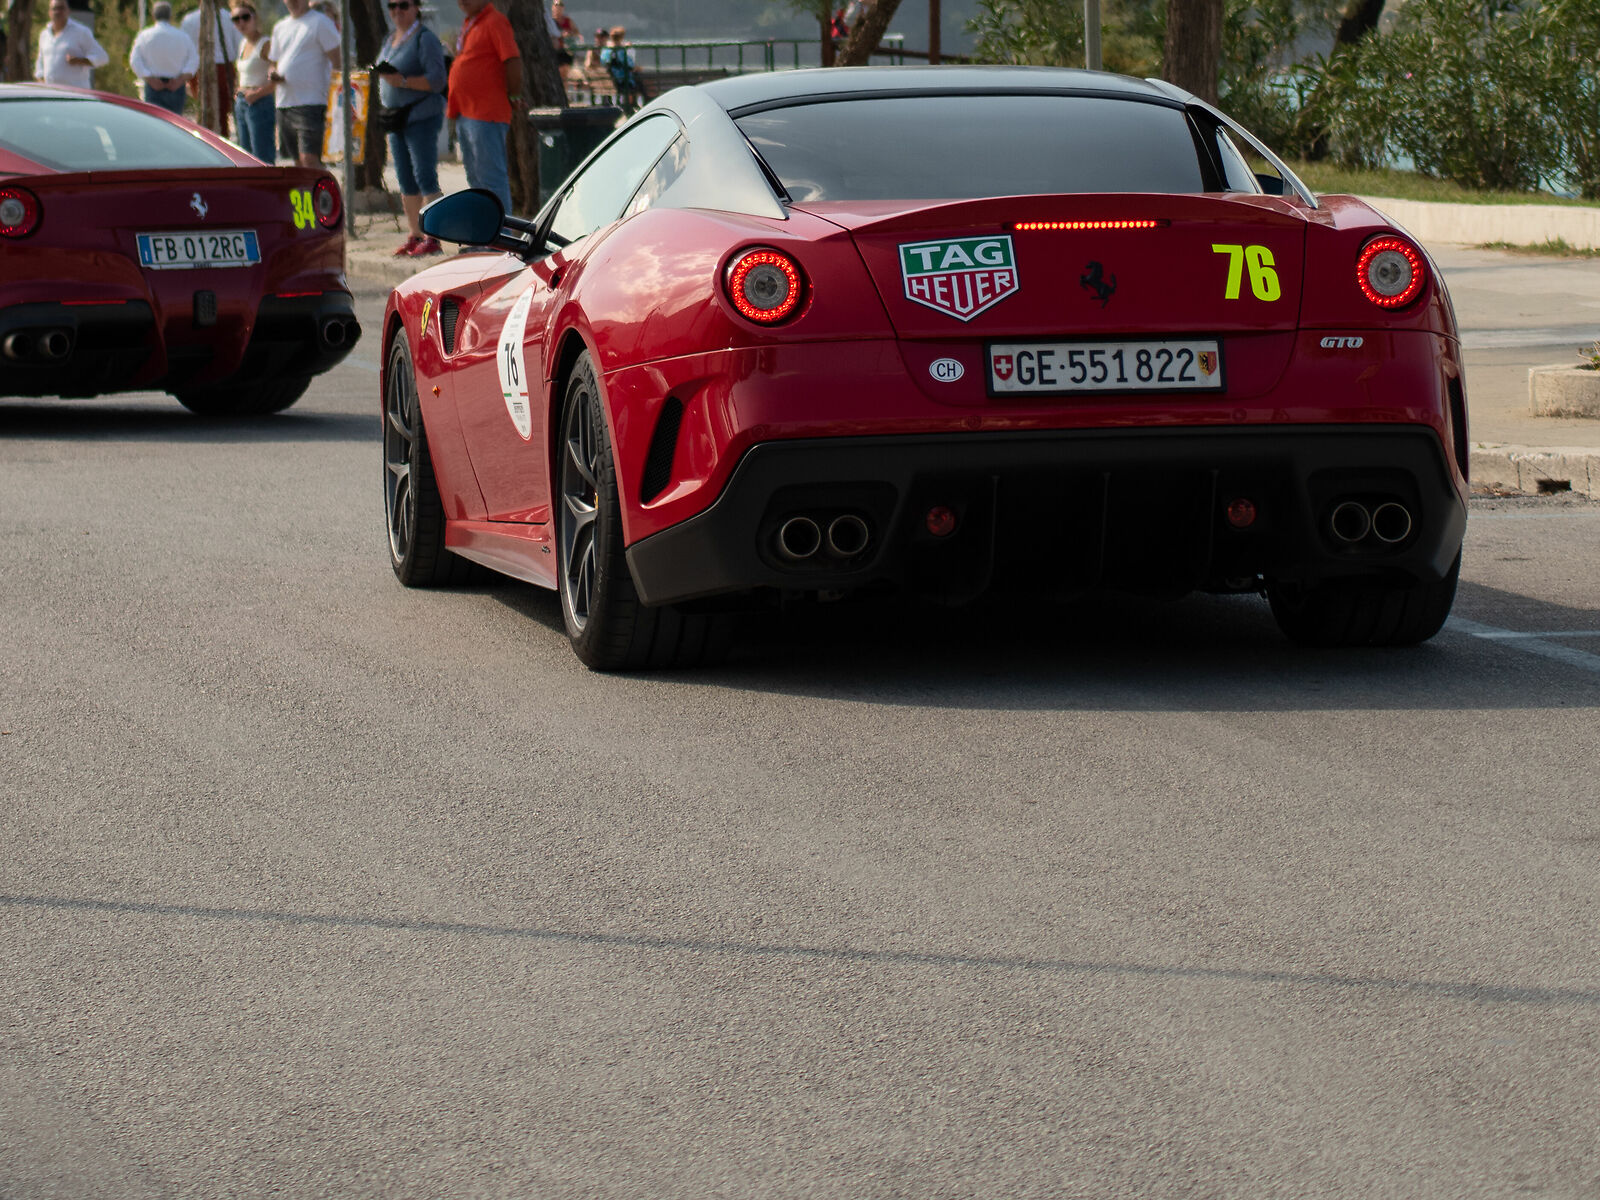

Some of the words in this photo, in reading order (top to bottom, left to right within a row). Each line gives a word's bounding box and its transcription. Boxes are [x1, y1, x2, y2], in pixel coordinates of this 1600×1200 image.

[289, 189, 316, 230] 34
[152, 238, 178, 260] FB
[184, 236, 245, 259] 012RG
[909, 241, 1004, 270] TAG
[1211, 244, 1282, 302] 76
[910, 271, 1011, 314] HEUER
[1320, 336, 1363, 348] GTO
[504, 341, 519, 387] 76
[935, 361, 957, 378] CH
